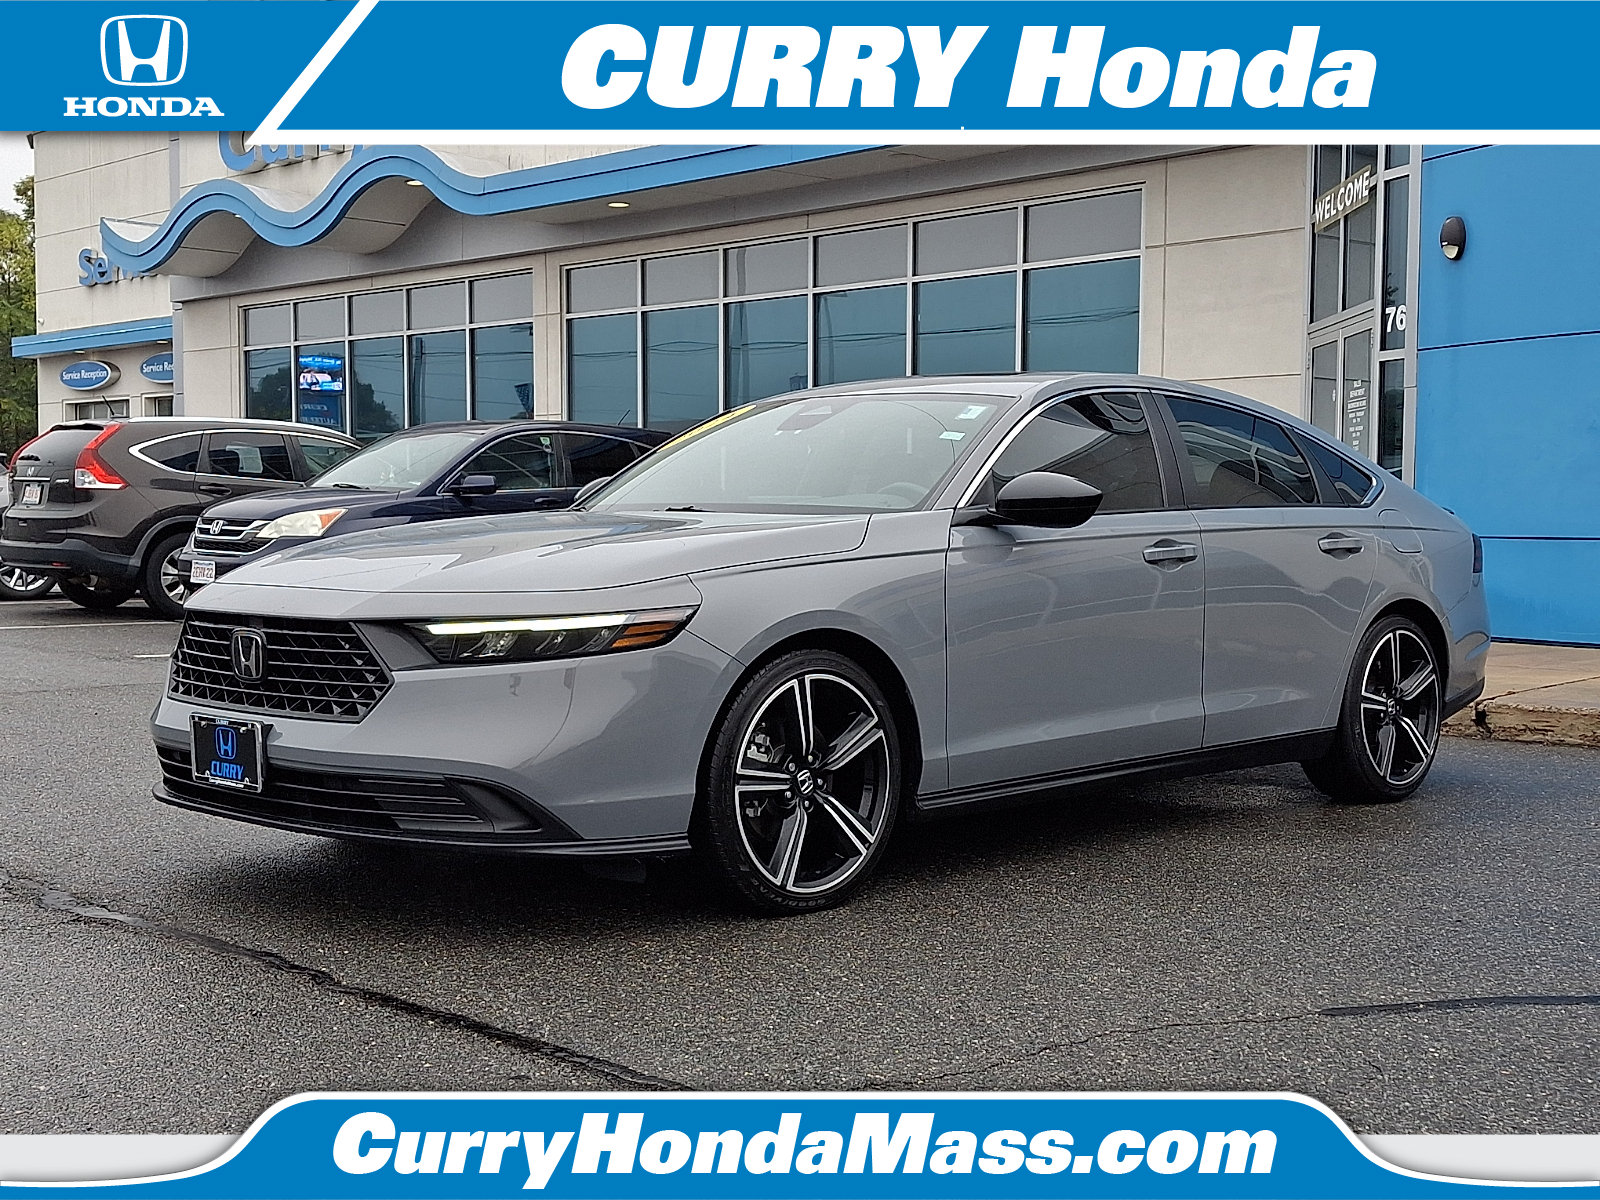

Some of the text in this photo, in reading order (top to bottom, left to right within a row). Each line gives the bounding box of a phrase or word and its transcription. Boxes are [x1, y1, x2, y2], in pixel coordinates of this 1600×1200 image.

[1315, 170, 1371, 224] WELCOME
[1385, 305, 1407, 332] 76
[62, 369, 107, 381] Service Reception
[143, 363, 163, 373] Service
[211, 760, 244, 780] CURRY
